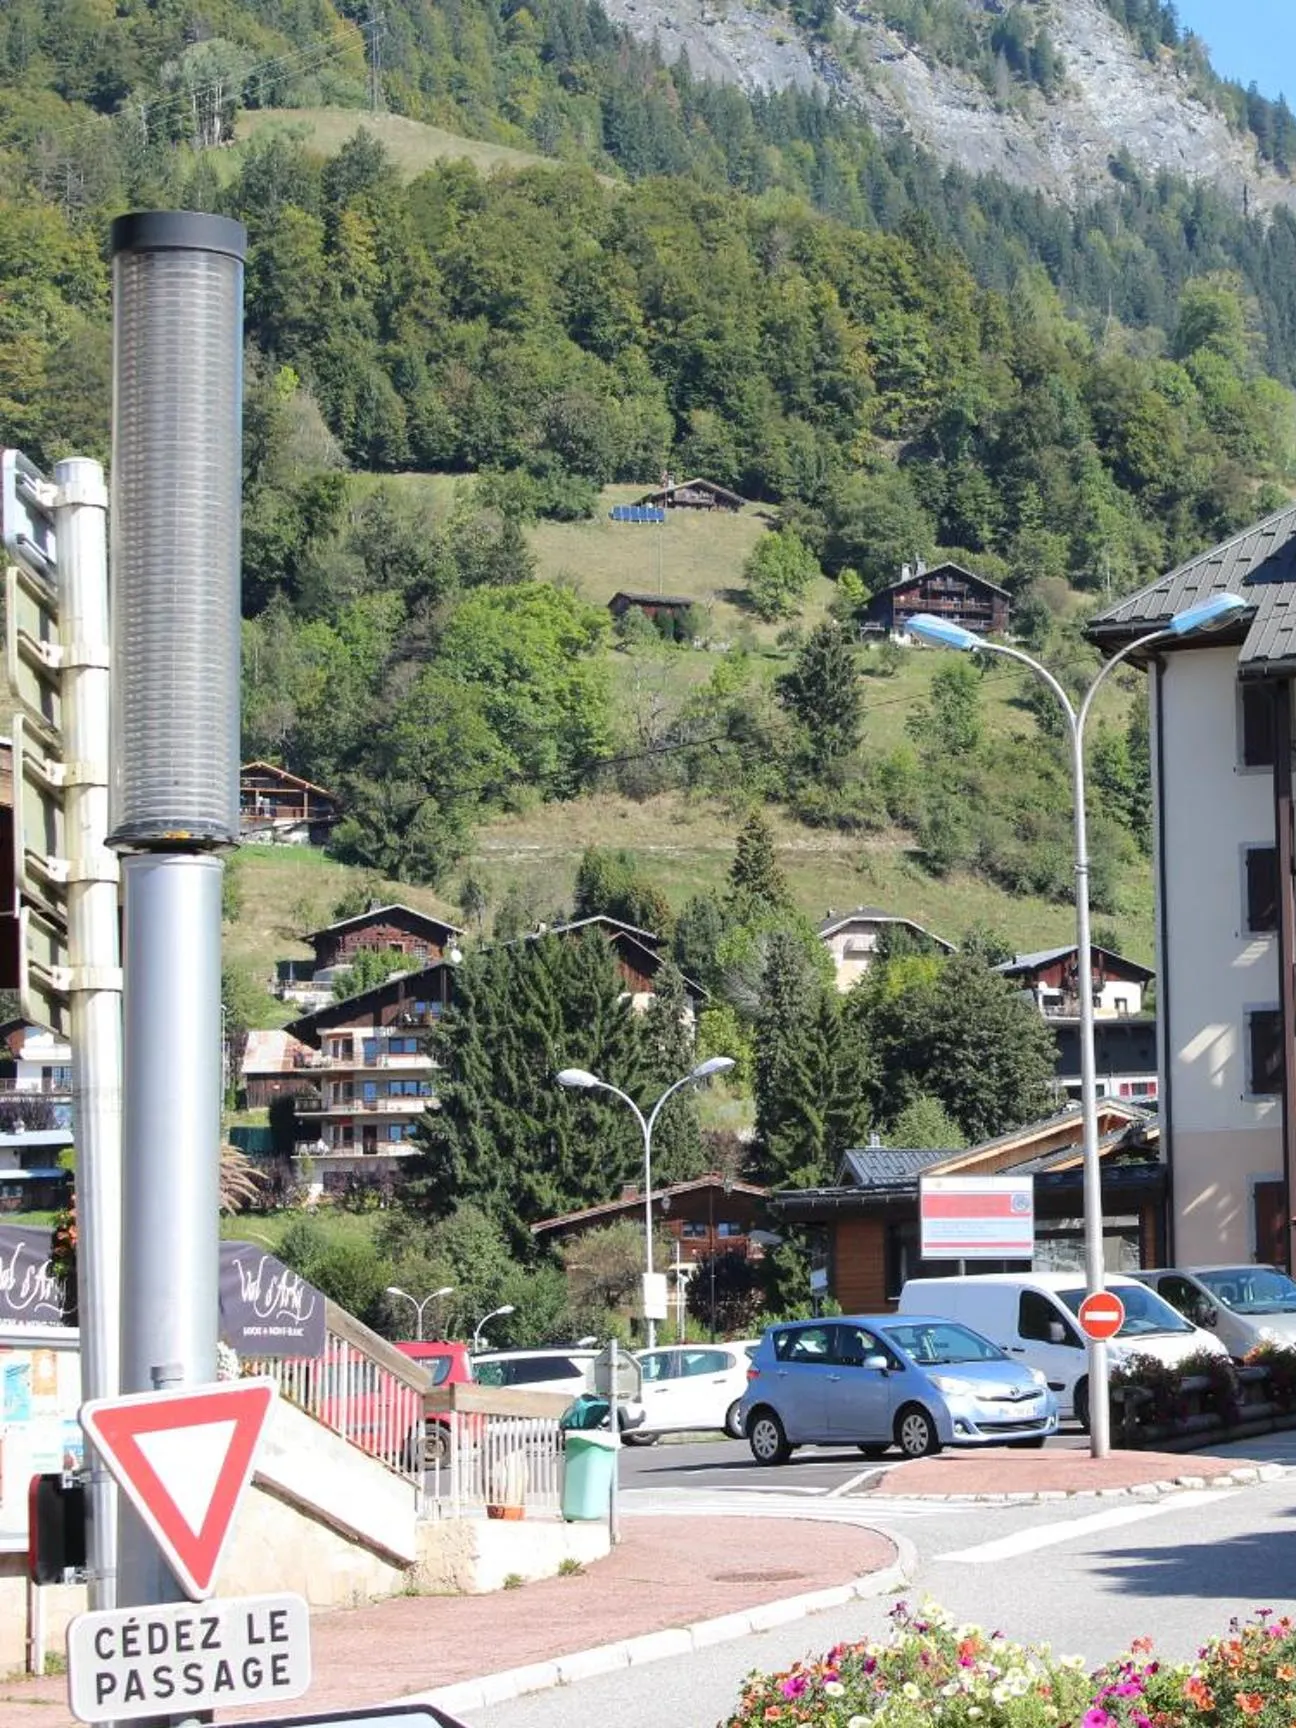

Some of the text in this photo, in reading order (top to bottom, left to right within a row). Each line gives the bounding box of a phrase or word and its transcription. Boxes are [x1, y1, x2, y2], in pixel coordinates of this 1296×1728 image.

[94, 1609, 290, 1661] CÉDEZ LE
[95, 1653, 291, 1706] PASSAGE
